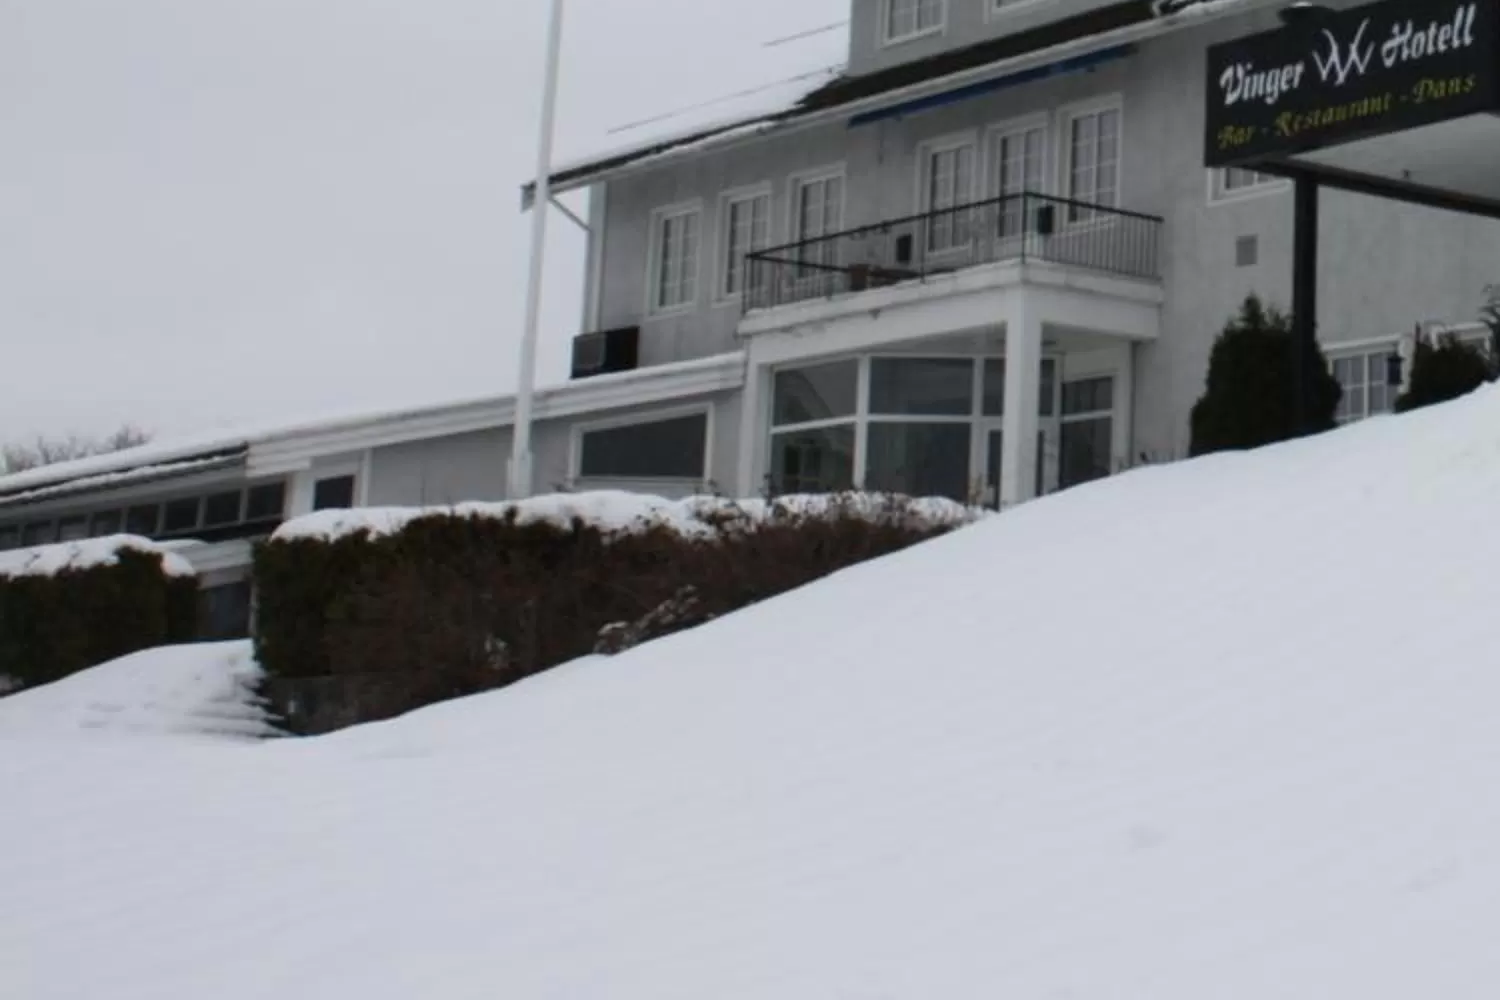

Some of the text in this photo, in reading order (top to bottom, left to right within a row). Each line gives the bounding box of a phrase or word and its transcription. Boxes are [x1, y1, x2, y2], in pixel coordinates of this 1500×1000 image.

[1219, 61, 1305, 105] Vinger
[1381, 3, 1477, 69] Hotell
[1218, 125, 1255, 149] Bar
[1274, 92, 1392, 138] Restaurant
[1412, 74, 1477, 105] Dans
